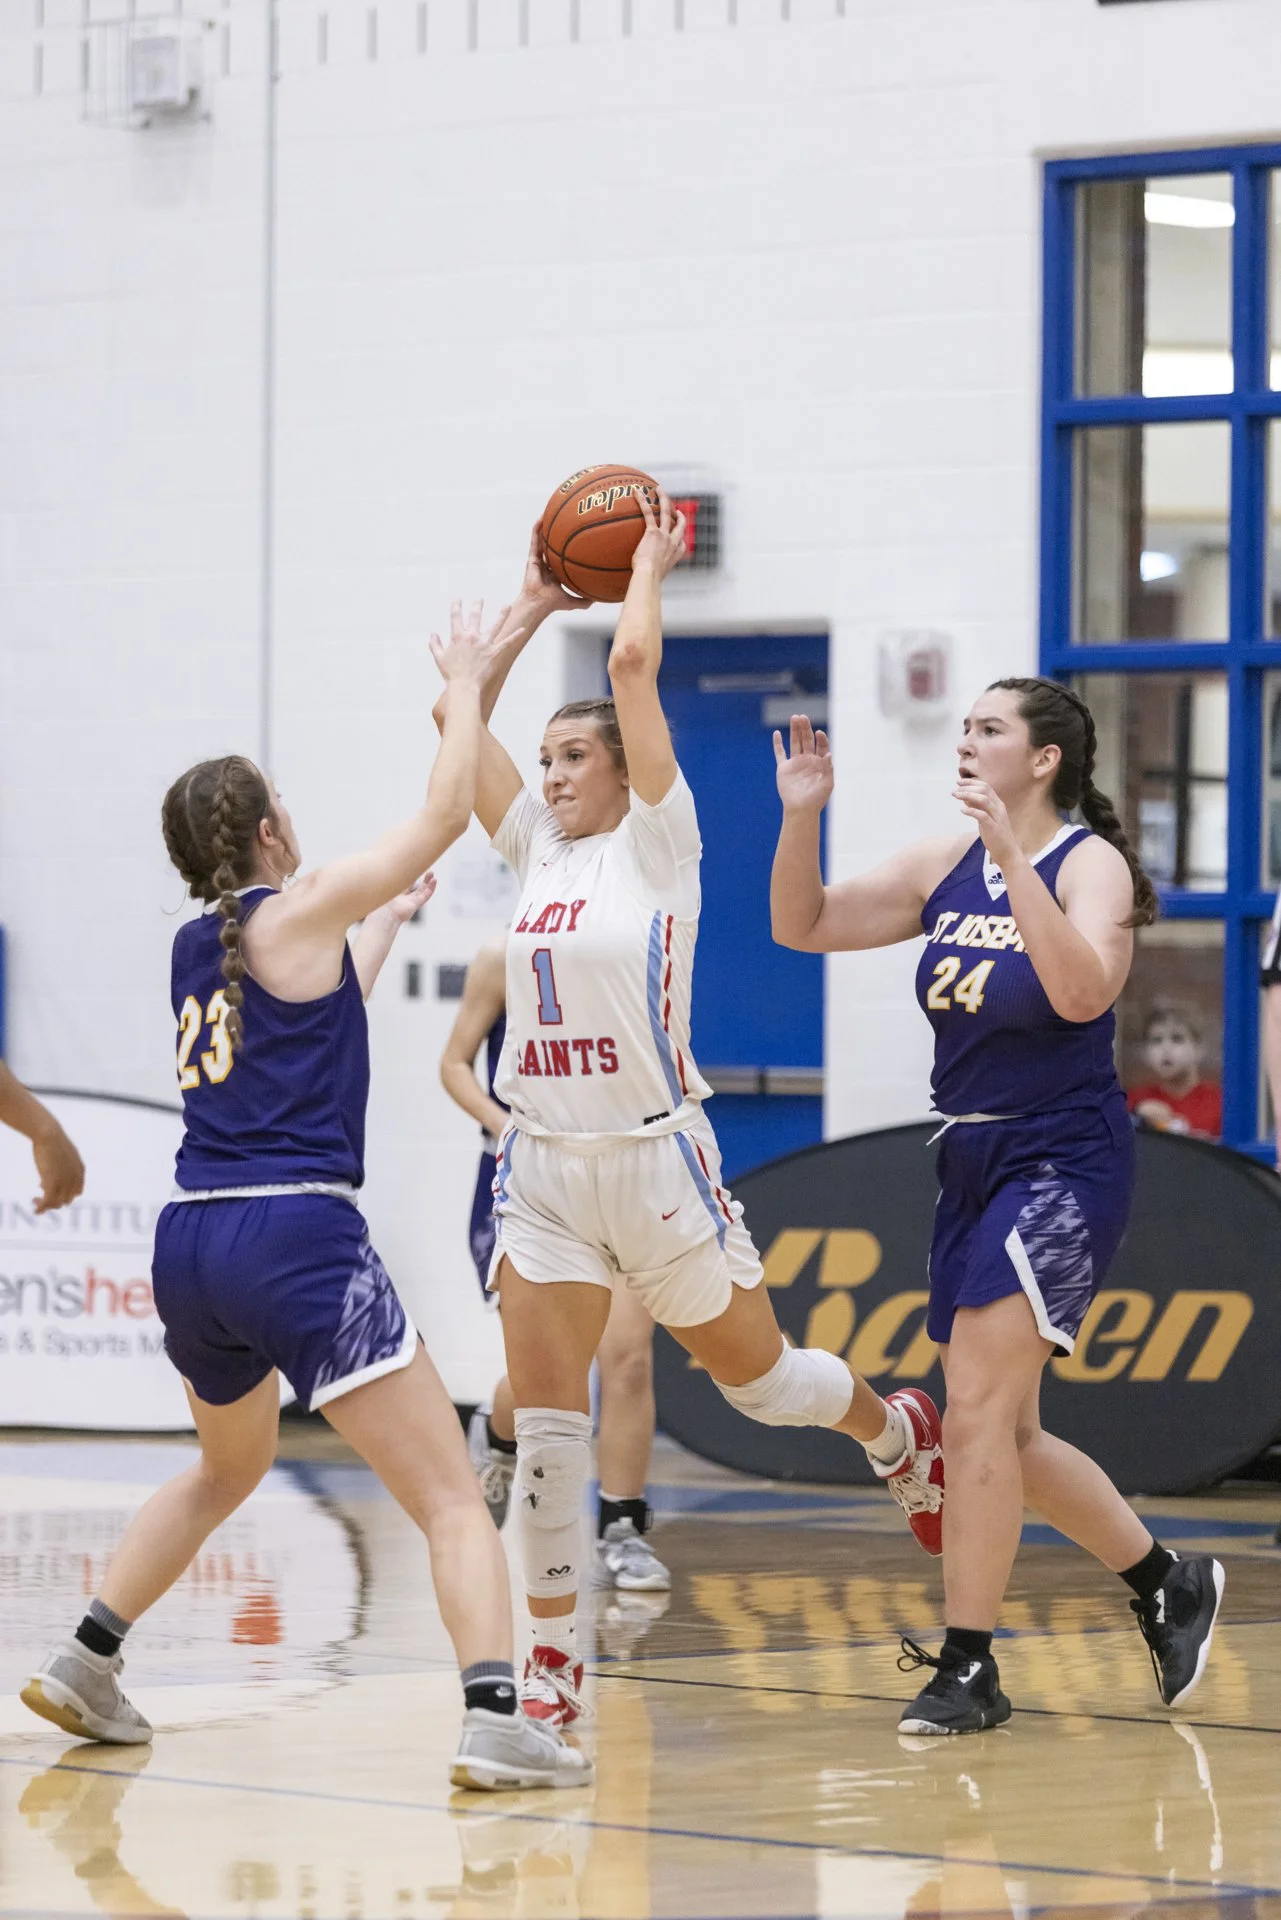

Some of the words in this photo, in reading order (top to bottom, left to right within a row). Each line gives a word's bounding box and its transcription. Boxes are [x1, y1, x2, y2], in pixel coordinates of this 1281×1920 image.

[515, 899, 587, 934] LADY
[532, 948, 563, 1025] 1
[927, 956, 996, 1014] 24
[177, 989, 234, 1090] 23
[687, 1228, 1254, 1383] Baen
